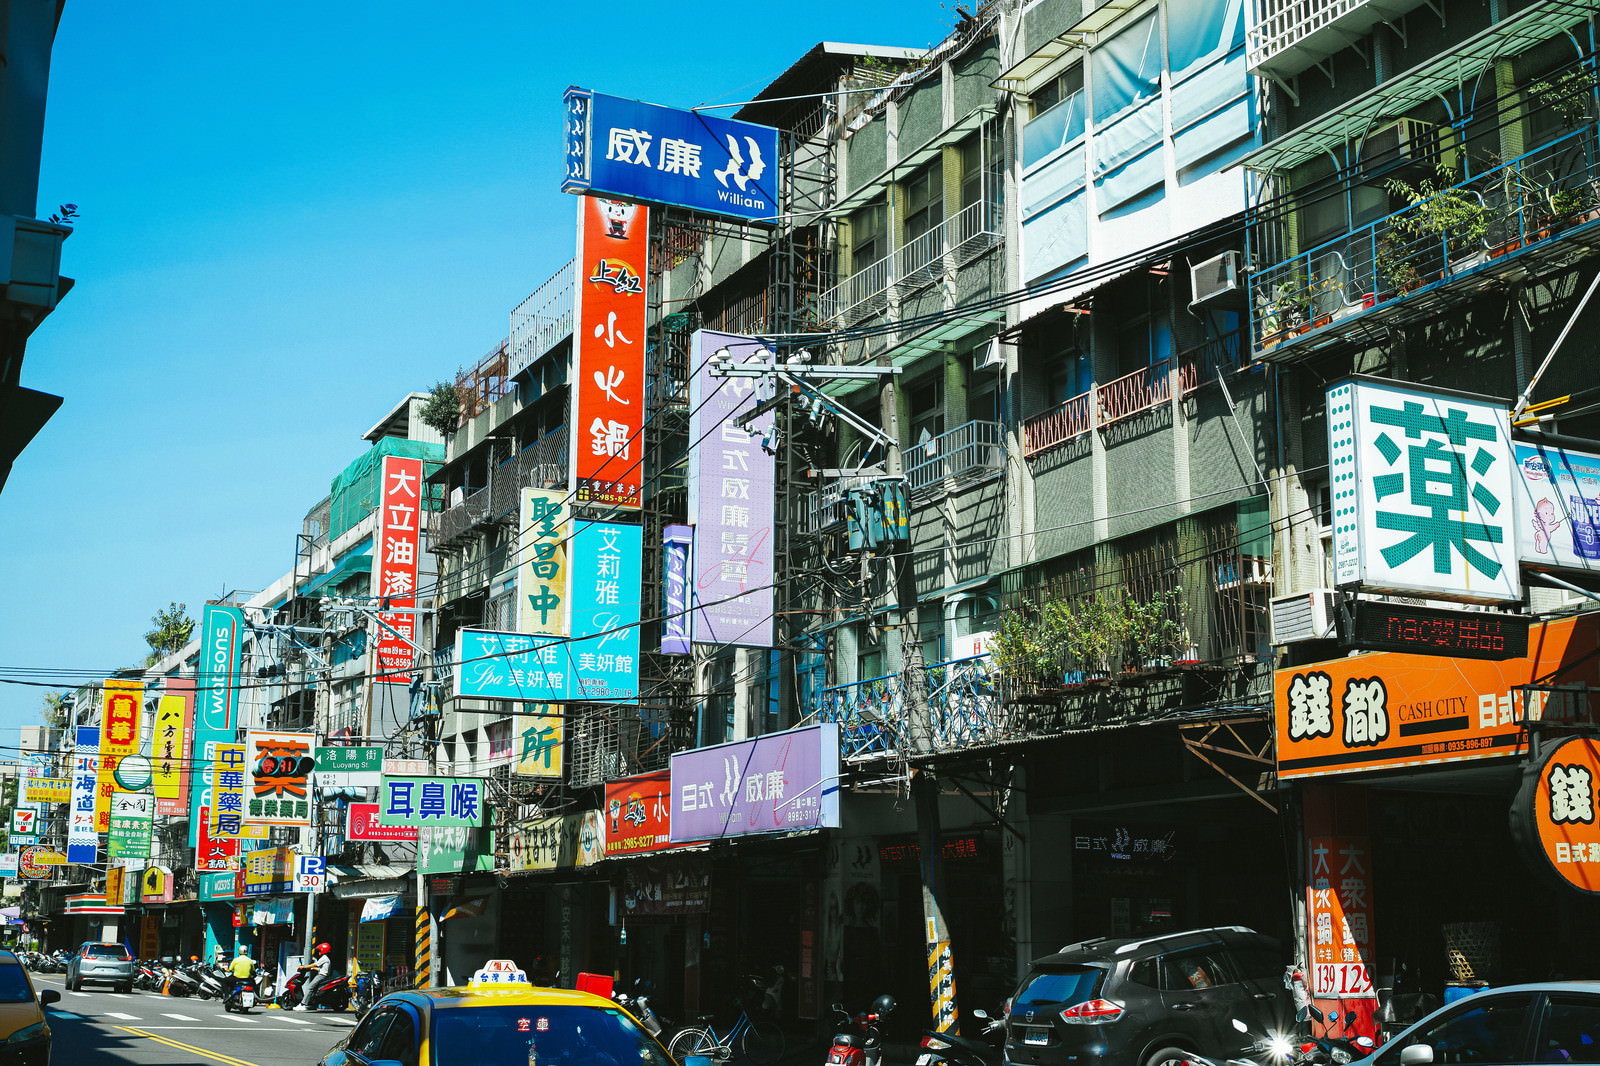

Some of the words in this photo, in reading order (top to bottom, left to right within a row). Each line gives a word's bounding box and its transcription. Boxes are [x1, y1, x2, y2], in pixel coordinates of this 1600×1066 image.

[606, 127, 703, 179] 威廉
[717, 189, 765, 210] William
[589, 311, 633, 461] 小火鍋
[384, 469, 417, 598] 大立油漆
[595, 526, 622, 605] 艾莉雅
[592, 612, 630, 649] Spa
[476, 635, 559, 665] 艾莉雅
[578, 652, 633, 674] 美妍館
[210, 626, 230, 714] watsons
[466, 662, 504, 692] Spa
[508, 670, 564, 690] 美妍館
[110, 698, 134, 742] 萬華
[1289, 673, 1388, 745] 錢都
[1398, 703, 1432, 722] CASH
[1436, 696, 1469, 714] CITY
[161, 712, 180, 778] 八方雲集
[326, 749, 377, 761] 洛陽街
[75, 757, 97, 812] 北海道
[332, 762, 360, 770] Luoyang
[216, 748, 245, 835] 中華藥局
[385, 781, 479, 820] 耳鼻喉
[653, 791, 669, 823] 小
[681, 780, 714, 812] 日式
[745, 769, 785, 803] 威廉
[1550, 767, 1593, 821] 錢
[1074, 836, 1108, 851] 日式
[302, 875, 320, 887] 30
[304, 857, 321, 874] P
[1316, 964, 1336, 994] 139
[1338, 964, 1375, 994] 129
[517, 1016, 550, 1032] 空車
